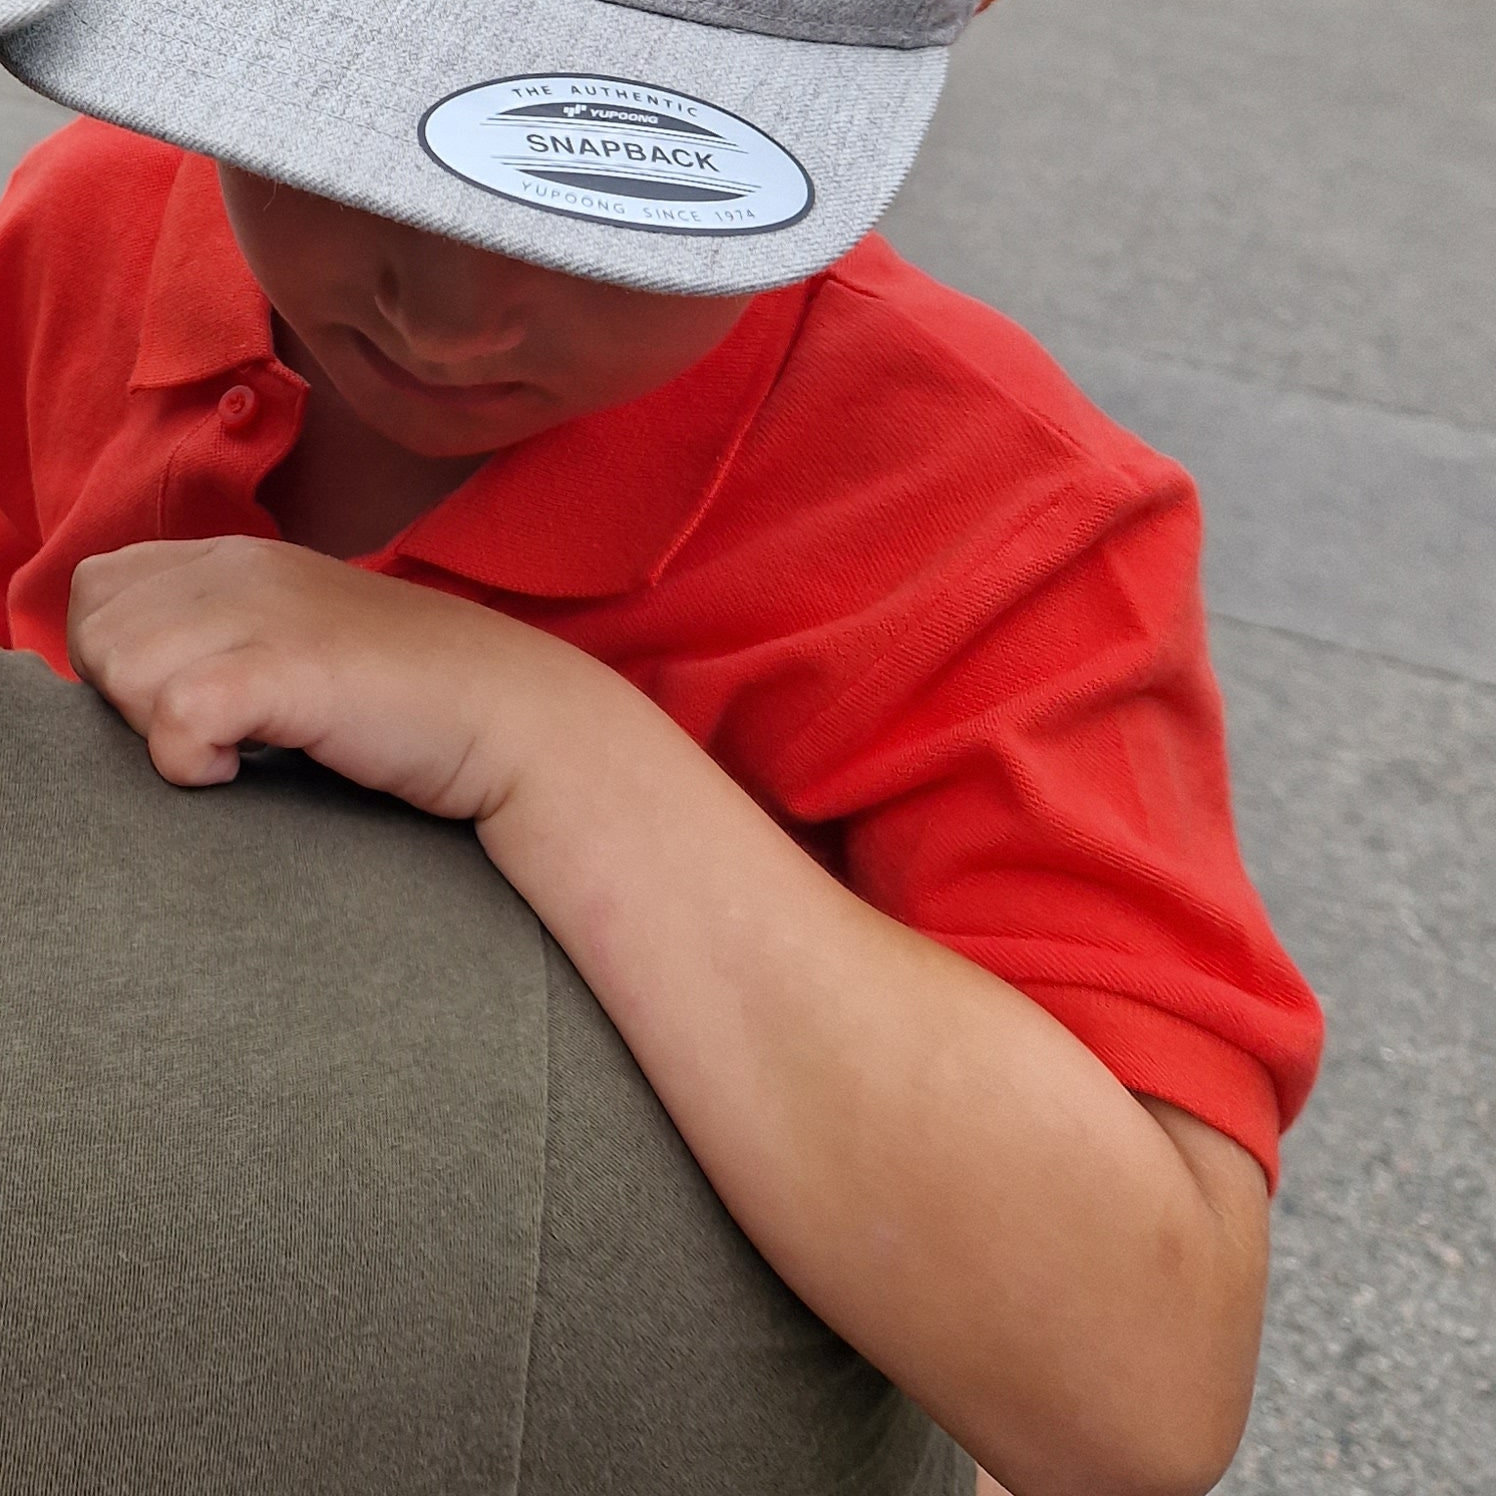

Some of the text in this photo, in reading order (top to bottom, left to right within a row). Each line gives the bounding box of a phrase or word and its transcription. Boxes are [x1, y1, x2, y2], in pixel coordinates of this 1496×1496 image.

[512, 84, 698, 118] THE AUTHENTIC
[589, 108, 659, 125] YUPOONG
[525, 133, 721, 173] SNAPBACK
[520, 181, 756, 223] YUPOONG SINCE 1974
